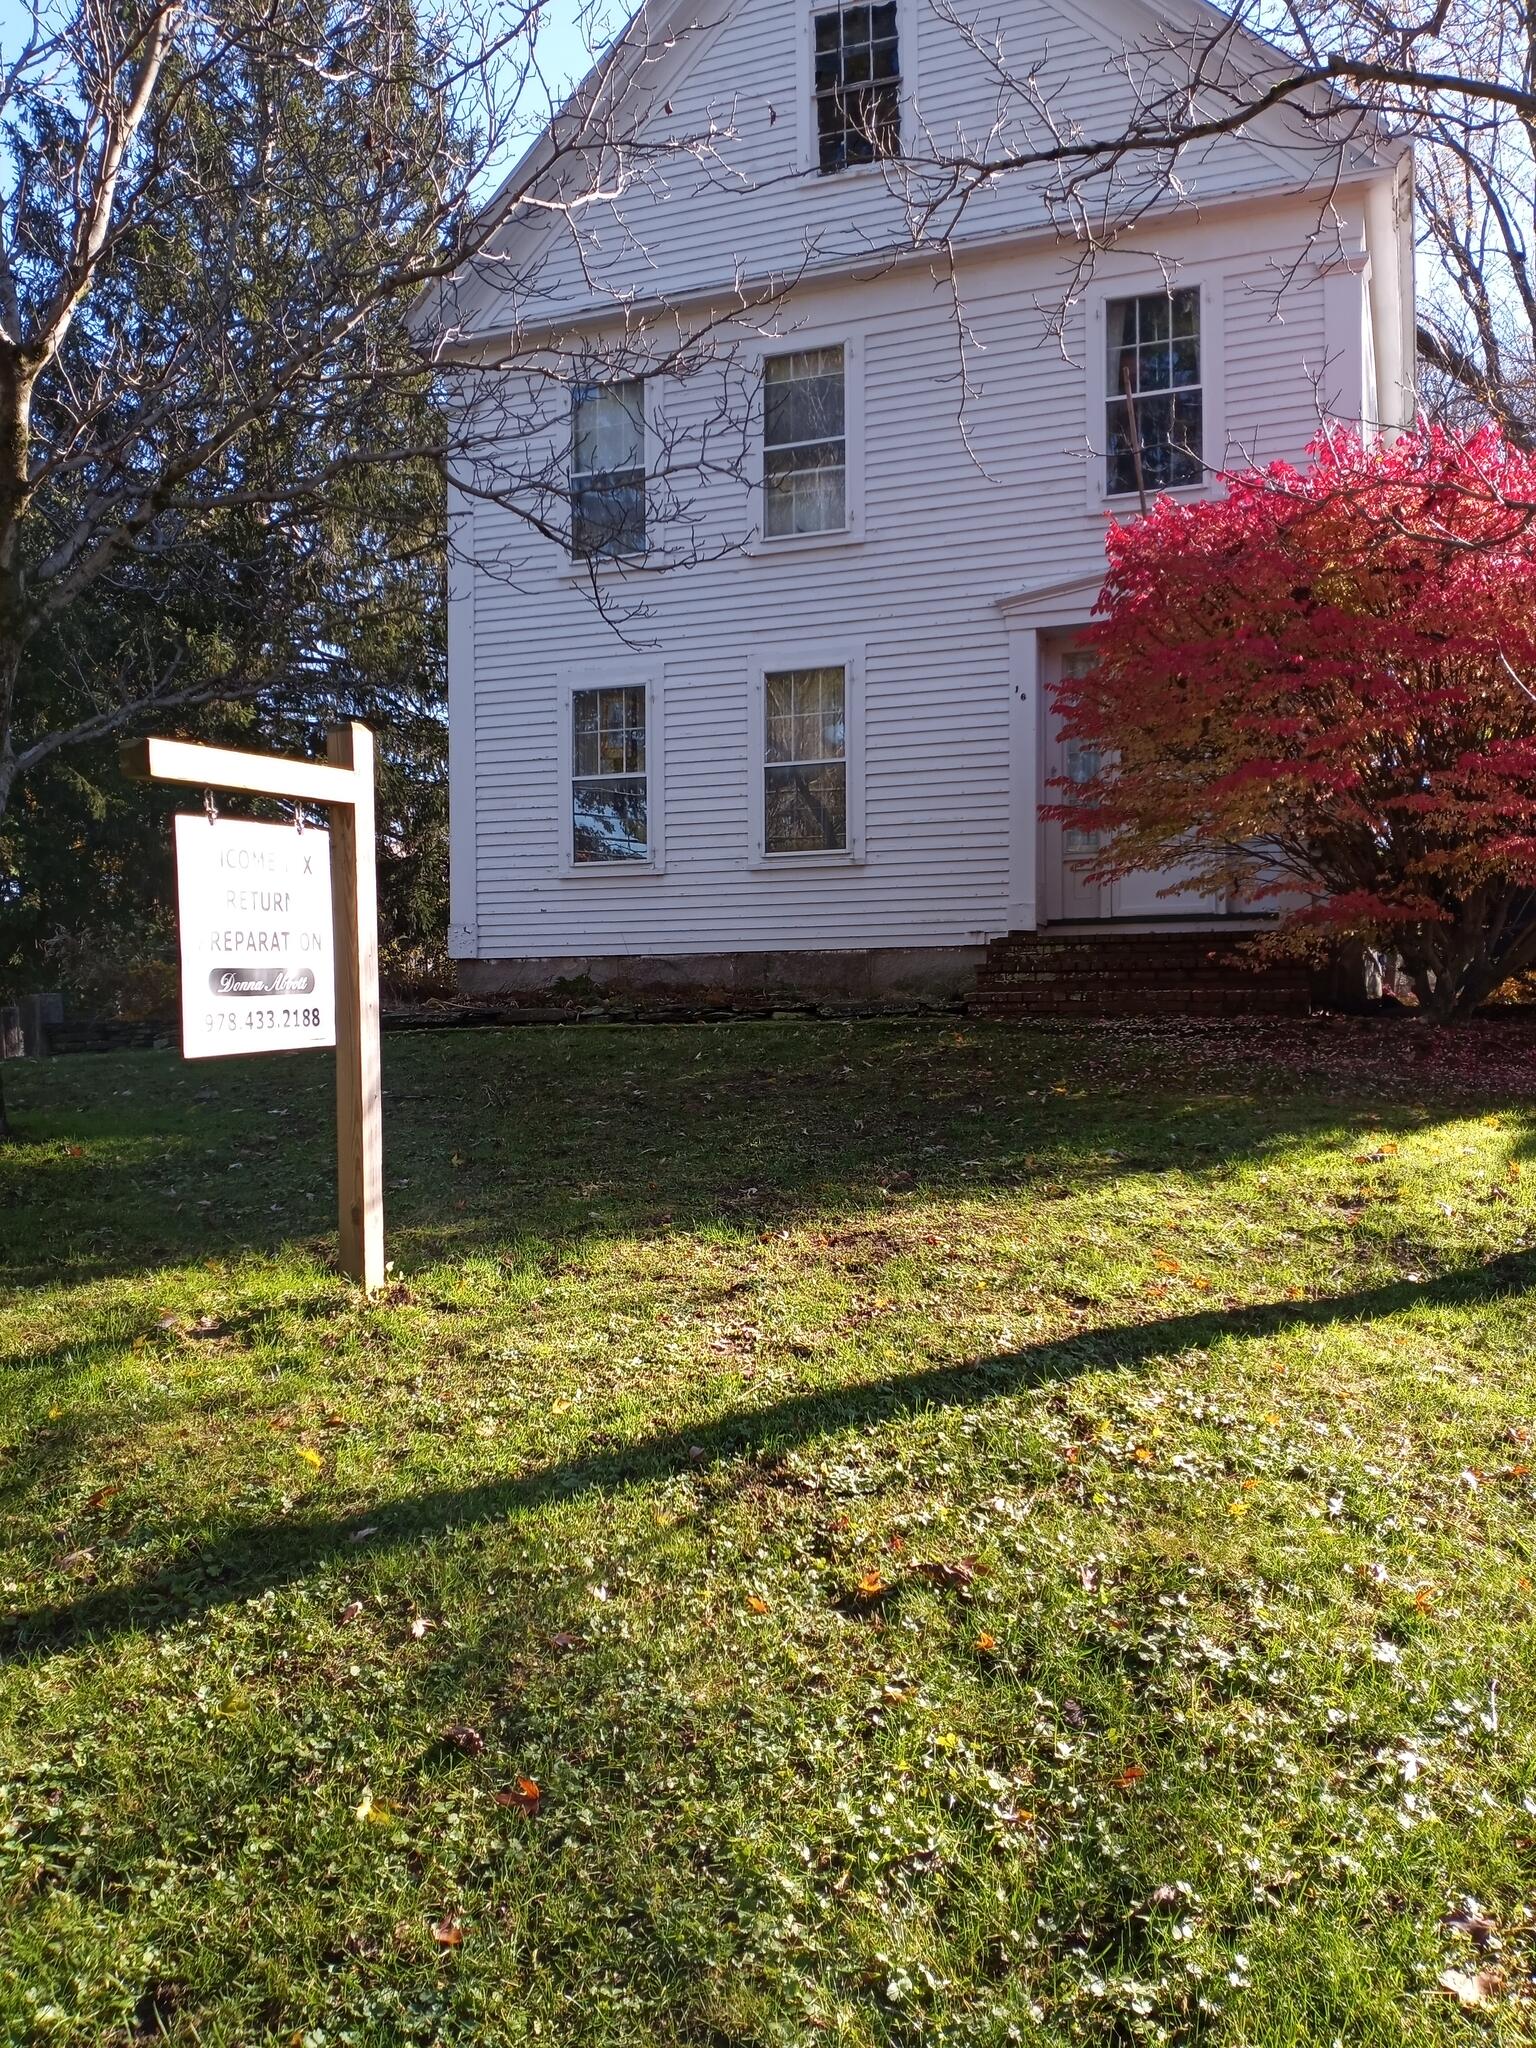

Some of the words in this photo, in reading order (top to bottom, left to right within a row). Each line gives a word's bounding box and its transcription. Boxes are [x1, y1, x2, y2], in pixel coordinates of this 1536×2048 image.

[1014, 685, 1027, 701] 16
[219, 848, 276, 872] COME
[198, 930, 322, 953] REPARATON
[217, 972, 264, 993] Donna
[204, 1007, 321, 1033] 978.433.2188
